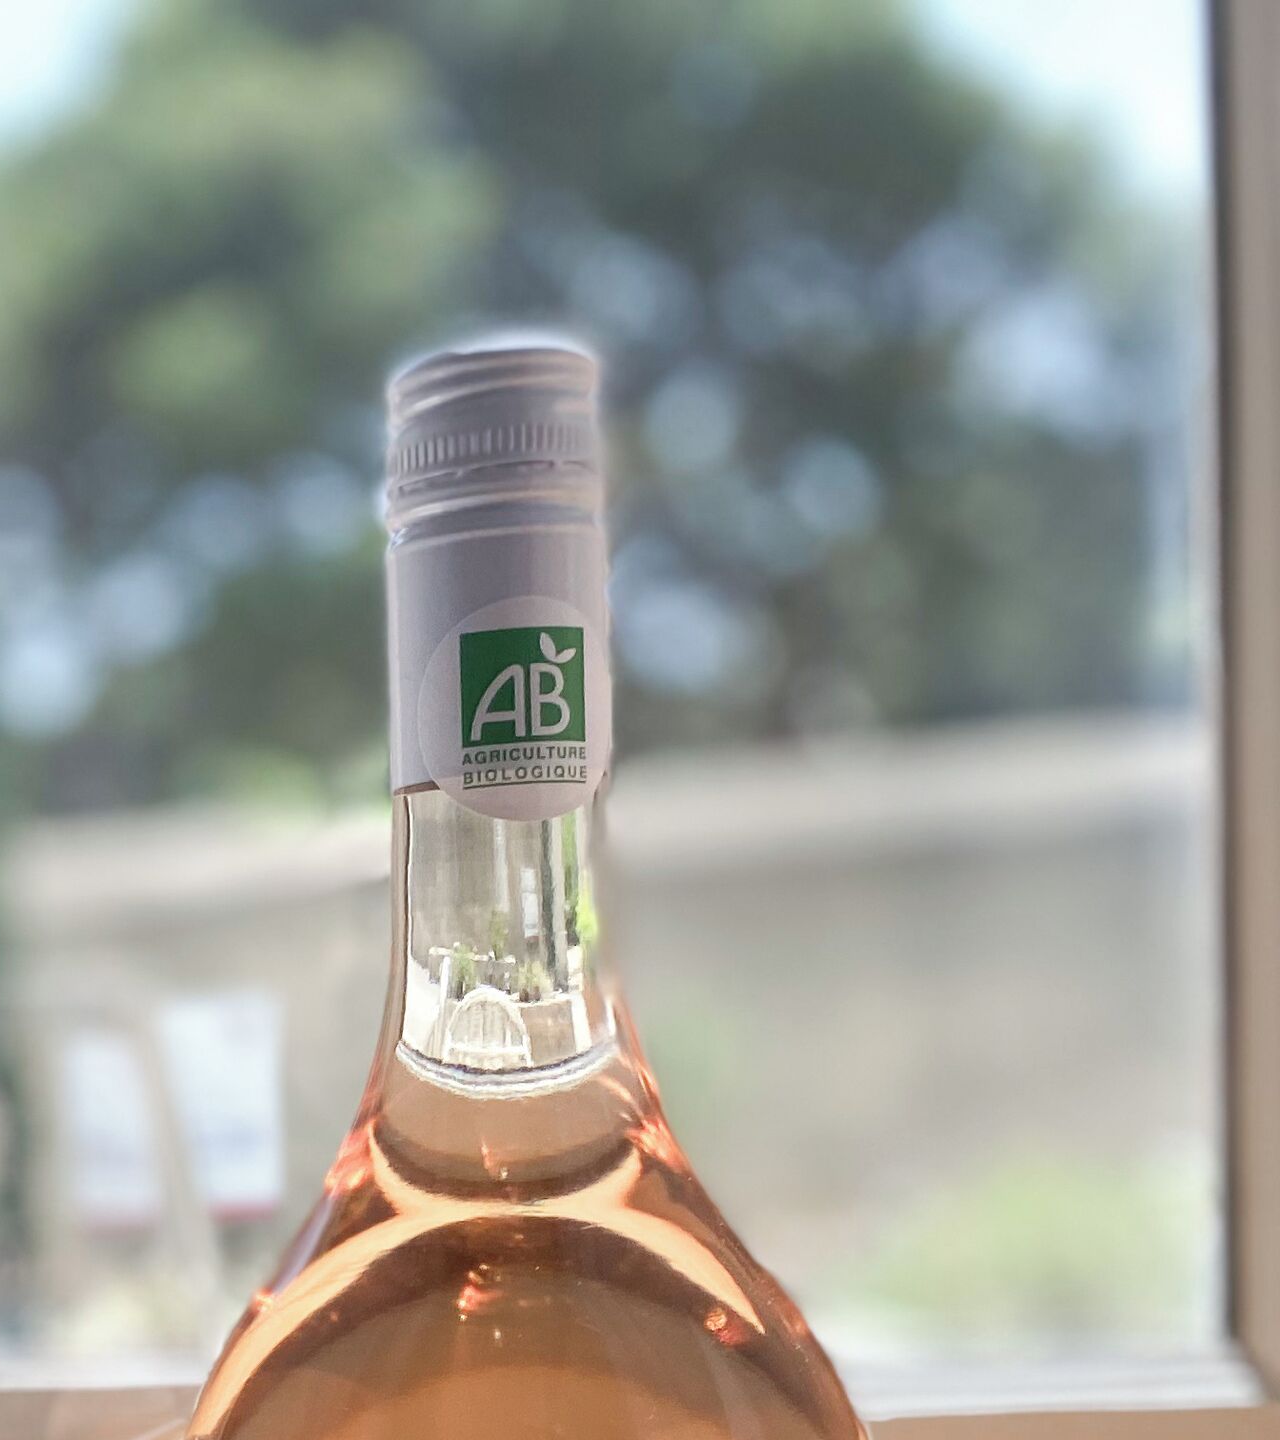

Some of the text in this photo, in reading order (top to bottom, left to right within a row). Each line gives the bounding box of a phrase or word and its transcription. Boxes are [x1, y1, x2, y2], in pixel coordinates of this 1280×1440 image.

[471, 662, 570, 741] AB
[462, 746, 586, 766] AGRICULTURE
[463, 765, 587, 785] BIOLOGIQUE
